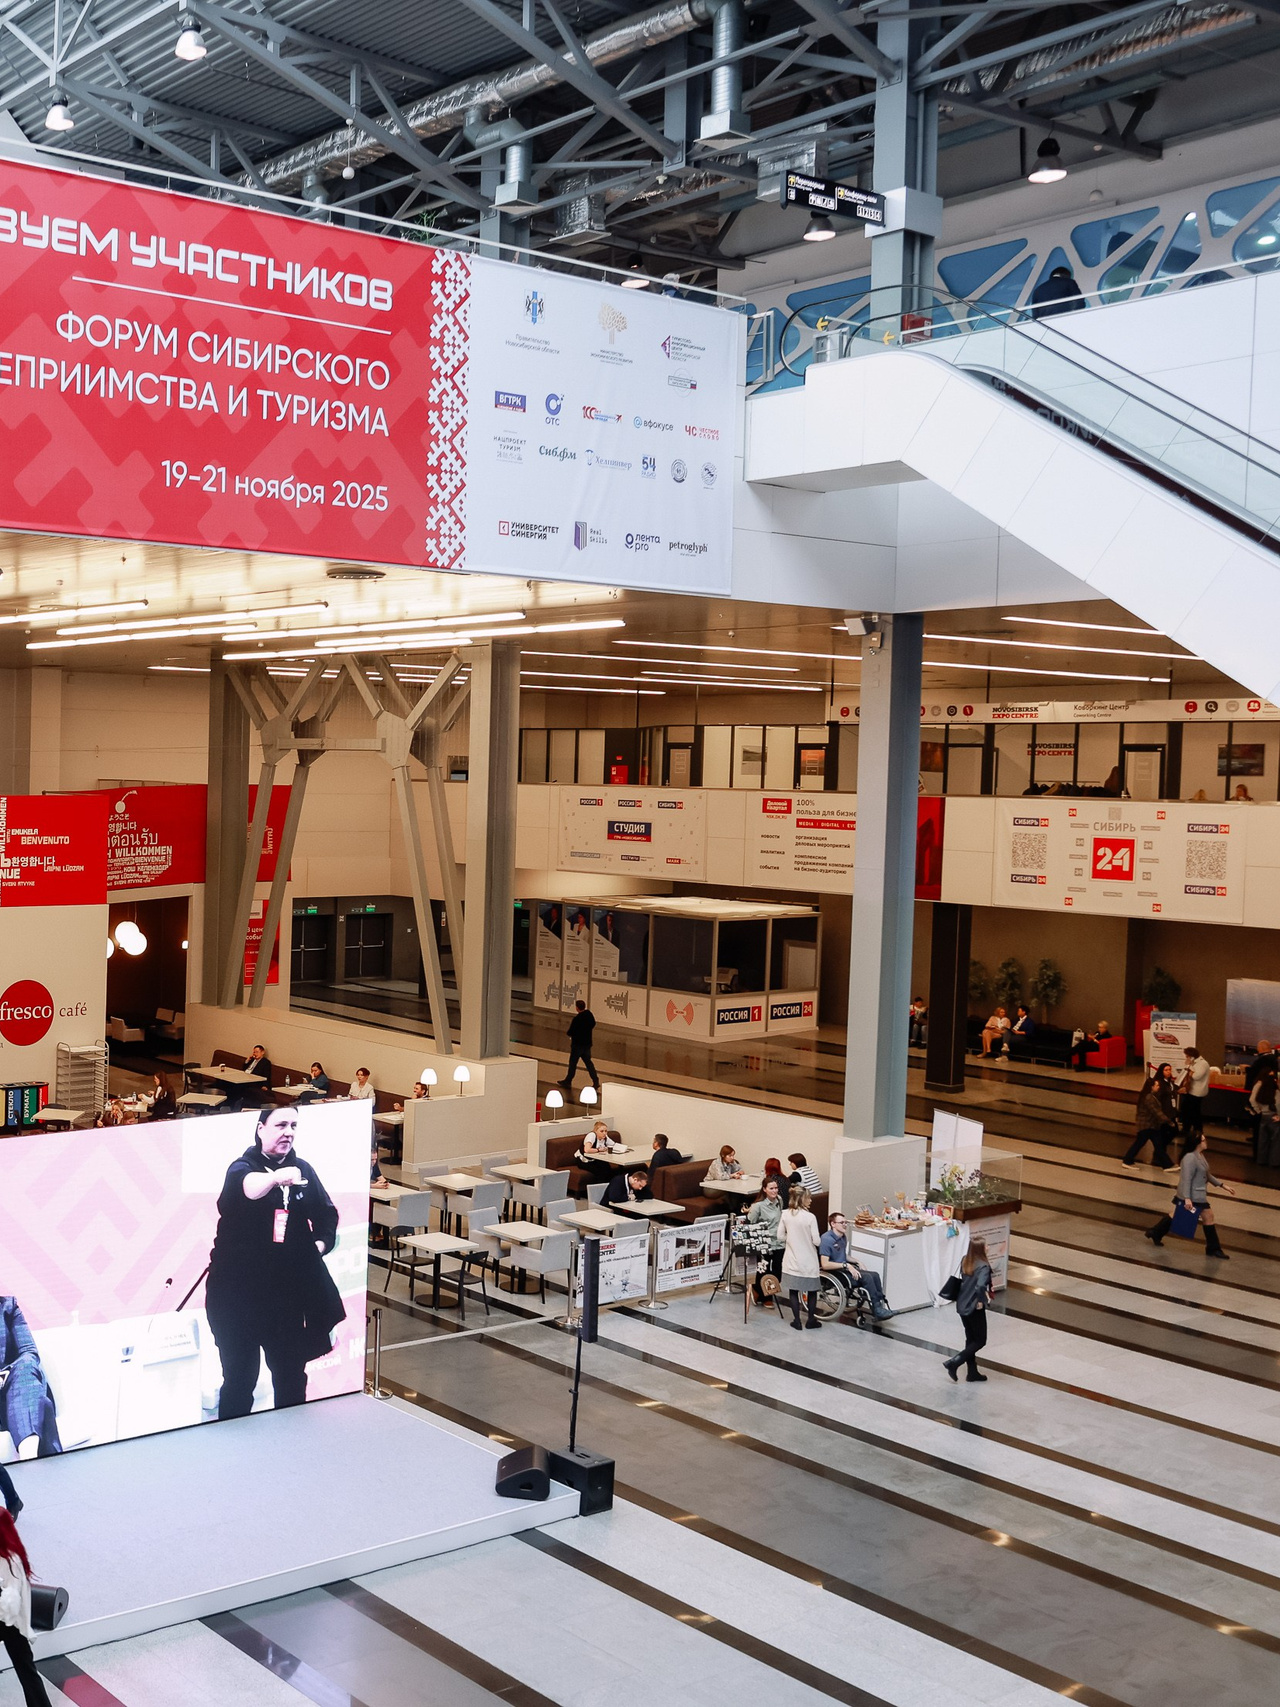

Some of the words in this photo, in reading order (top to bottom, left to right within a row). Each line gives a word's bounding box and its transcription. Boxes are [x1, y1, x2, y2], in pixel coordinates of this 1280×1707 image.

[130, 231, 393, 312] УЧАСТНИКОВ
[56, 310, 178, 358] ФОРУМ
[188, 329, 390, 390] СИБИРСКОГО
[499, 394, 522, 406] ВГТРК
[227, 384, 248, 418] И
[257, 387, 390, 437] ТУРИЗМА
[545, 416, 560, 426] ОТС
[644, 420, 674, 432] вфокусе
[685, 424, 698, 437] ЧС
[494, 436, 526, 446] НАЦПРОЕКТ
[500, 444, 521, 452] ТУРИЗМ
[642, 456, 656, 472] 54
[234, 470, 324, 507] ноября
[332, 482, 388, 512] 2025
[510, 522, 560, 534] УНИВЕРСИТЕТ
[510, 530, 548, 540] СИНЕРГИЯ
[635, 534, 660, 544] лента
[635, 542, 649, 552] pro
[669, 540, 708, 554] petroglyph
[614, 823, 645, 833] СТУДИЯ
[1093, 822, 1136, 832] СИБИРЬ
[1189, 824, 1218, 833] СИБИРЬ
[1220, 825, 1229, 833] 24
[21, 836, 69, 844] BENVENUTO
[116, 846, 172, 857] WILLKOMMEN
[11, 856, 55, 867] 환영합니다
[1096, 846, 1130, 872] 24
[1012, 875, 1036, 883] СИБИРЬ
[1038, 876, 1046, 884] 24
[1186, 886, 1215, 895] СИБИРЬ
[1217, 887, 1226, 896] 24
[0, 1001, 52, 1020] fresco
[60, 1002, 88, 1017] café
[720, 1011, 749, 1022] РОССИЯ
[753, 1008, 759, 1020] 1
[772, 1005, 801, 1016] РОССИЯ
[804, 1004, 812, 1014] 24
